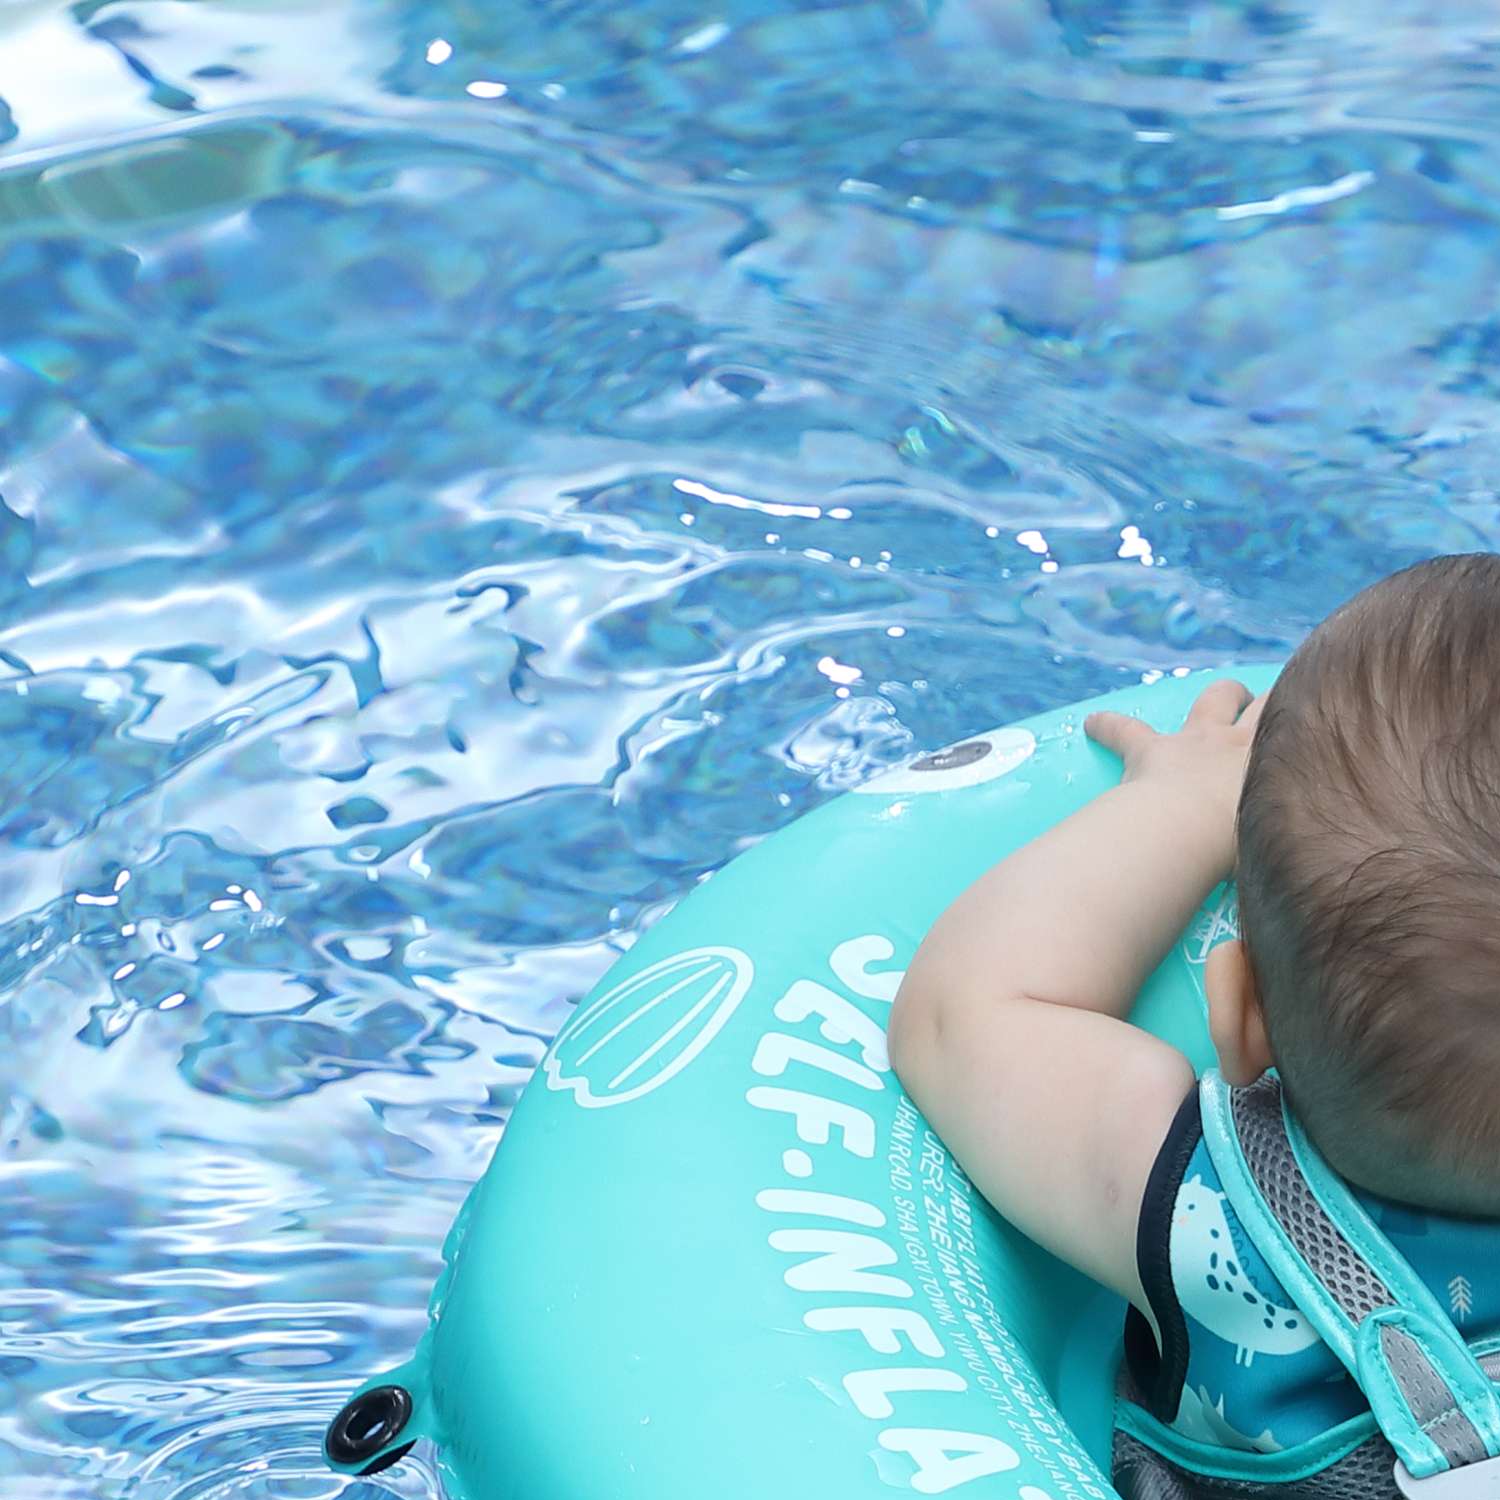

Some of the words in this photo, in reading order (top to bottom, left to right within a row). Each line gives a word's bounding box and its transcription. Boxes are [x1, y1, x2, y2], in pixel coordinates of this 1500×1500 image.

[917, 1276, 957, 1327] TOWN,
[948, 1329, 989, 1373] YIWU
[976, 1374, 1017, 1414] CITY,
